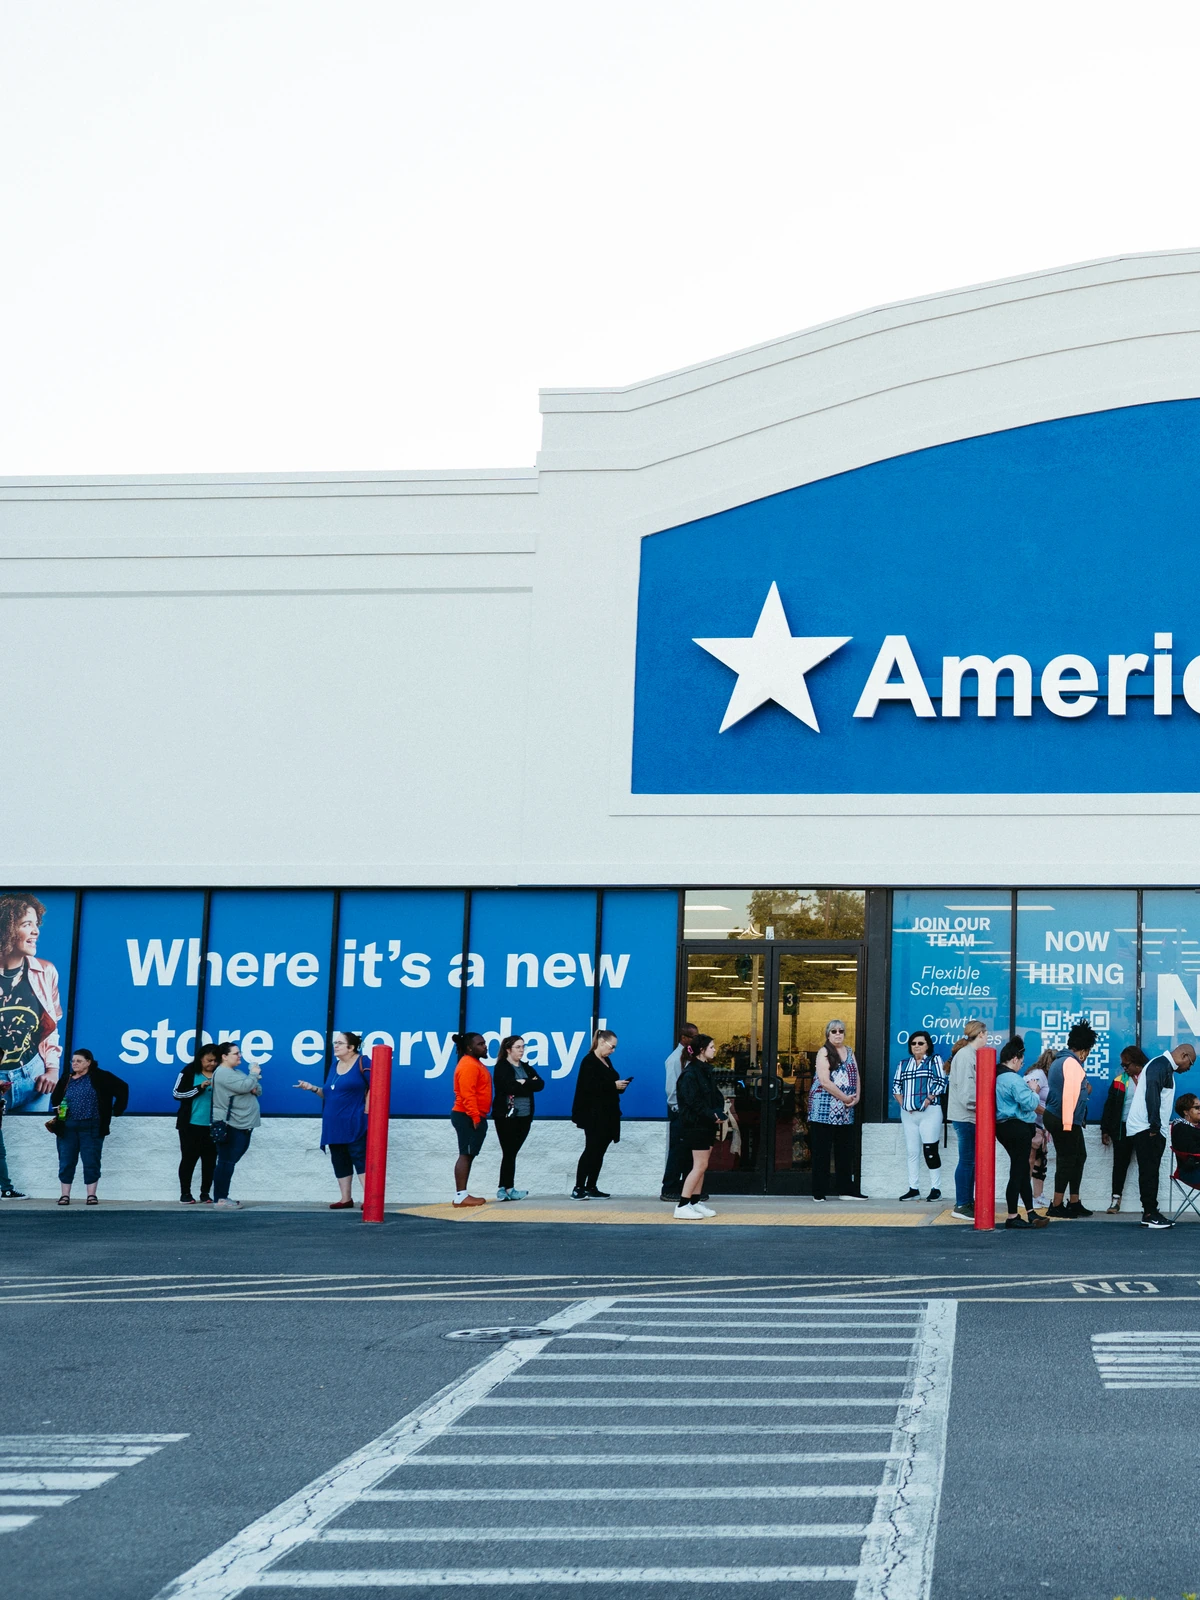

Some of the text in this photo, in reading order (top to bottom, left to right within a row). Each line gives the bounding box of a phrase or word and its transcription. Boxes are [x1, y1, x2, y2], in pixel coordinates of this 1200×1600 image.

[912, 917, 990, 931] JOIN OUR
[927, 933, 975, 947] TEAM
[1045, 931, 1110, 952] NOW
[126, 937, 631, 989] Where it's a new
[921, 966, 980, 980] Flexible
[1029, 963, 1124, 985] HIRING
[910, 981, 990, 996] Schedules
[786, 993, 794, 1007] 3
[1071, 1281, 1160, 1294] NO
